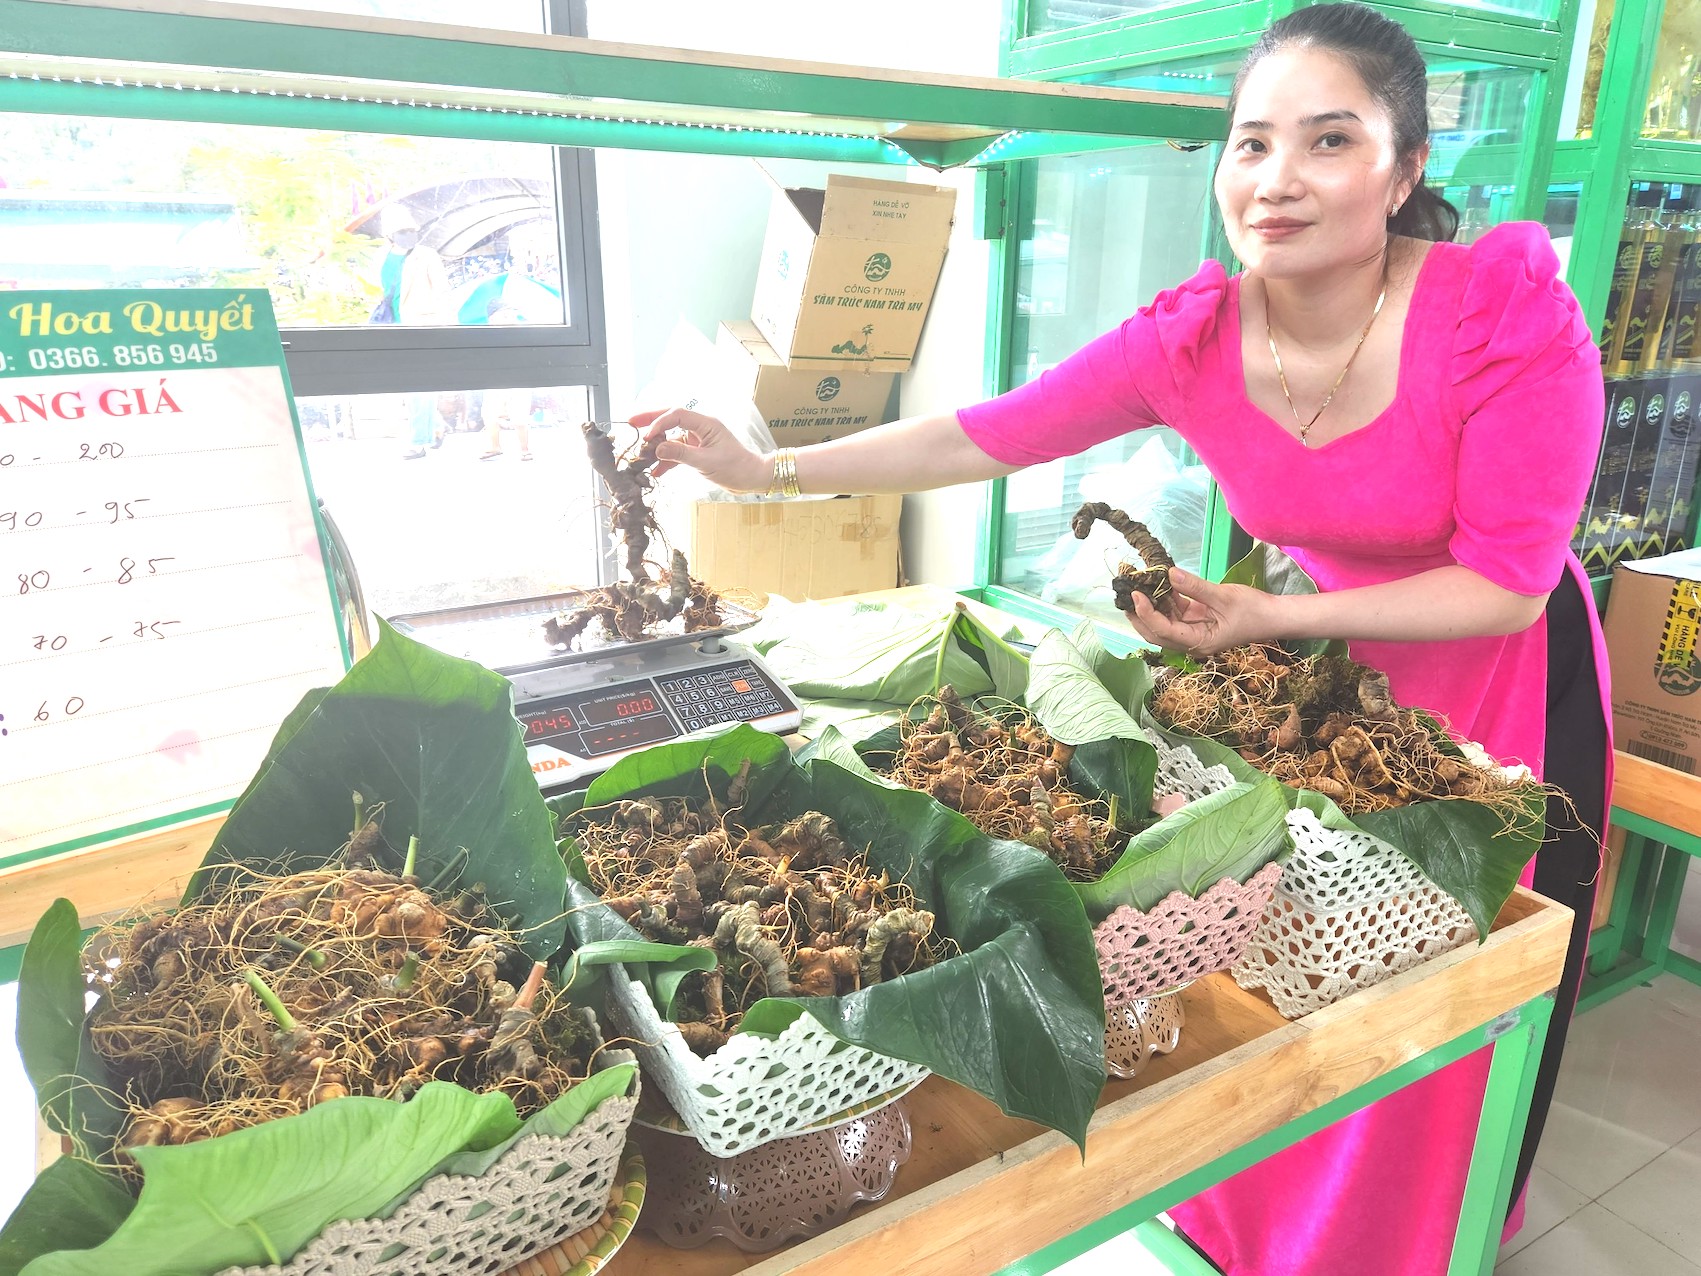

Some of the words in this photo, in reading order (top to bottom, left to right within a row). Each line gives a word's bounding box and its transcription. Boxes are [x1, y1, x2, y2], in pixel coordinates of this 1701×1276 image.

[844, 284, 870, 294] CÔNG
[884, 288, 906, 296] TNHH
[813, 293, 836, 305] SÂM
[863, 299, 886, 309] NAM
[907, 302, 923, 311] MY
[9, 301, 113, 336] Hoa
[123, 294, 255, 341] Quyết
[29, 347, 108, 370] 0366.
[113, 344, 164, 366] 856
[169, 342, 218, 364] 945
[99, 378, 183, 417] GIÁ
[794, 407, 818, 415] CÔNG
[815, 417, 835, 426] NAM
[853, 416, 868, 425] MY
[79, 442, 124, 460] 200
[0, 511, 43, 530] 90
[105, 499, 150, 524] 95
[17, 570, 50, 594] 80
[117, 557, 175, 585] 85
[32, 635, 67, 651] 70
[133, 620, 181, 640] 75
[1678, 625, 1690, 648] HÀNG
[698, 677, 707, 685] 3
[675, 695, 683, 703] 4
[691, 692, 699, 700] 5
[706, 688, 715, 696] 6
[33, 696, 84, 722] 60
[617, 698, 654, 716] 0.00
[684, 708, 692, 716] 7
[700, 705, 708, 713] 8
[690, 721, 699, 729] 0
[721, 713, 732, 721] M1
[767, 703, 779, 711] M4
